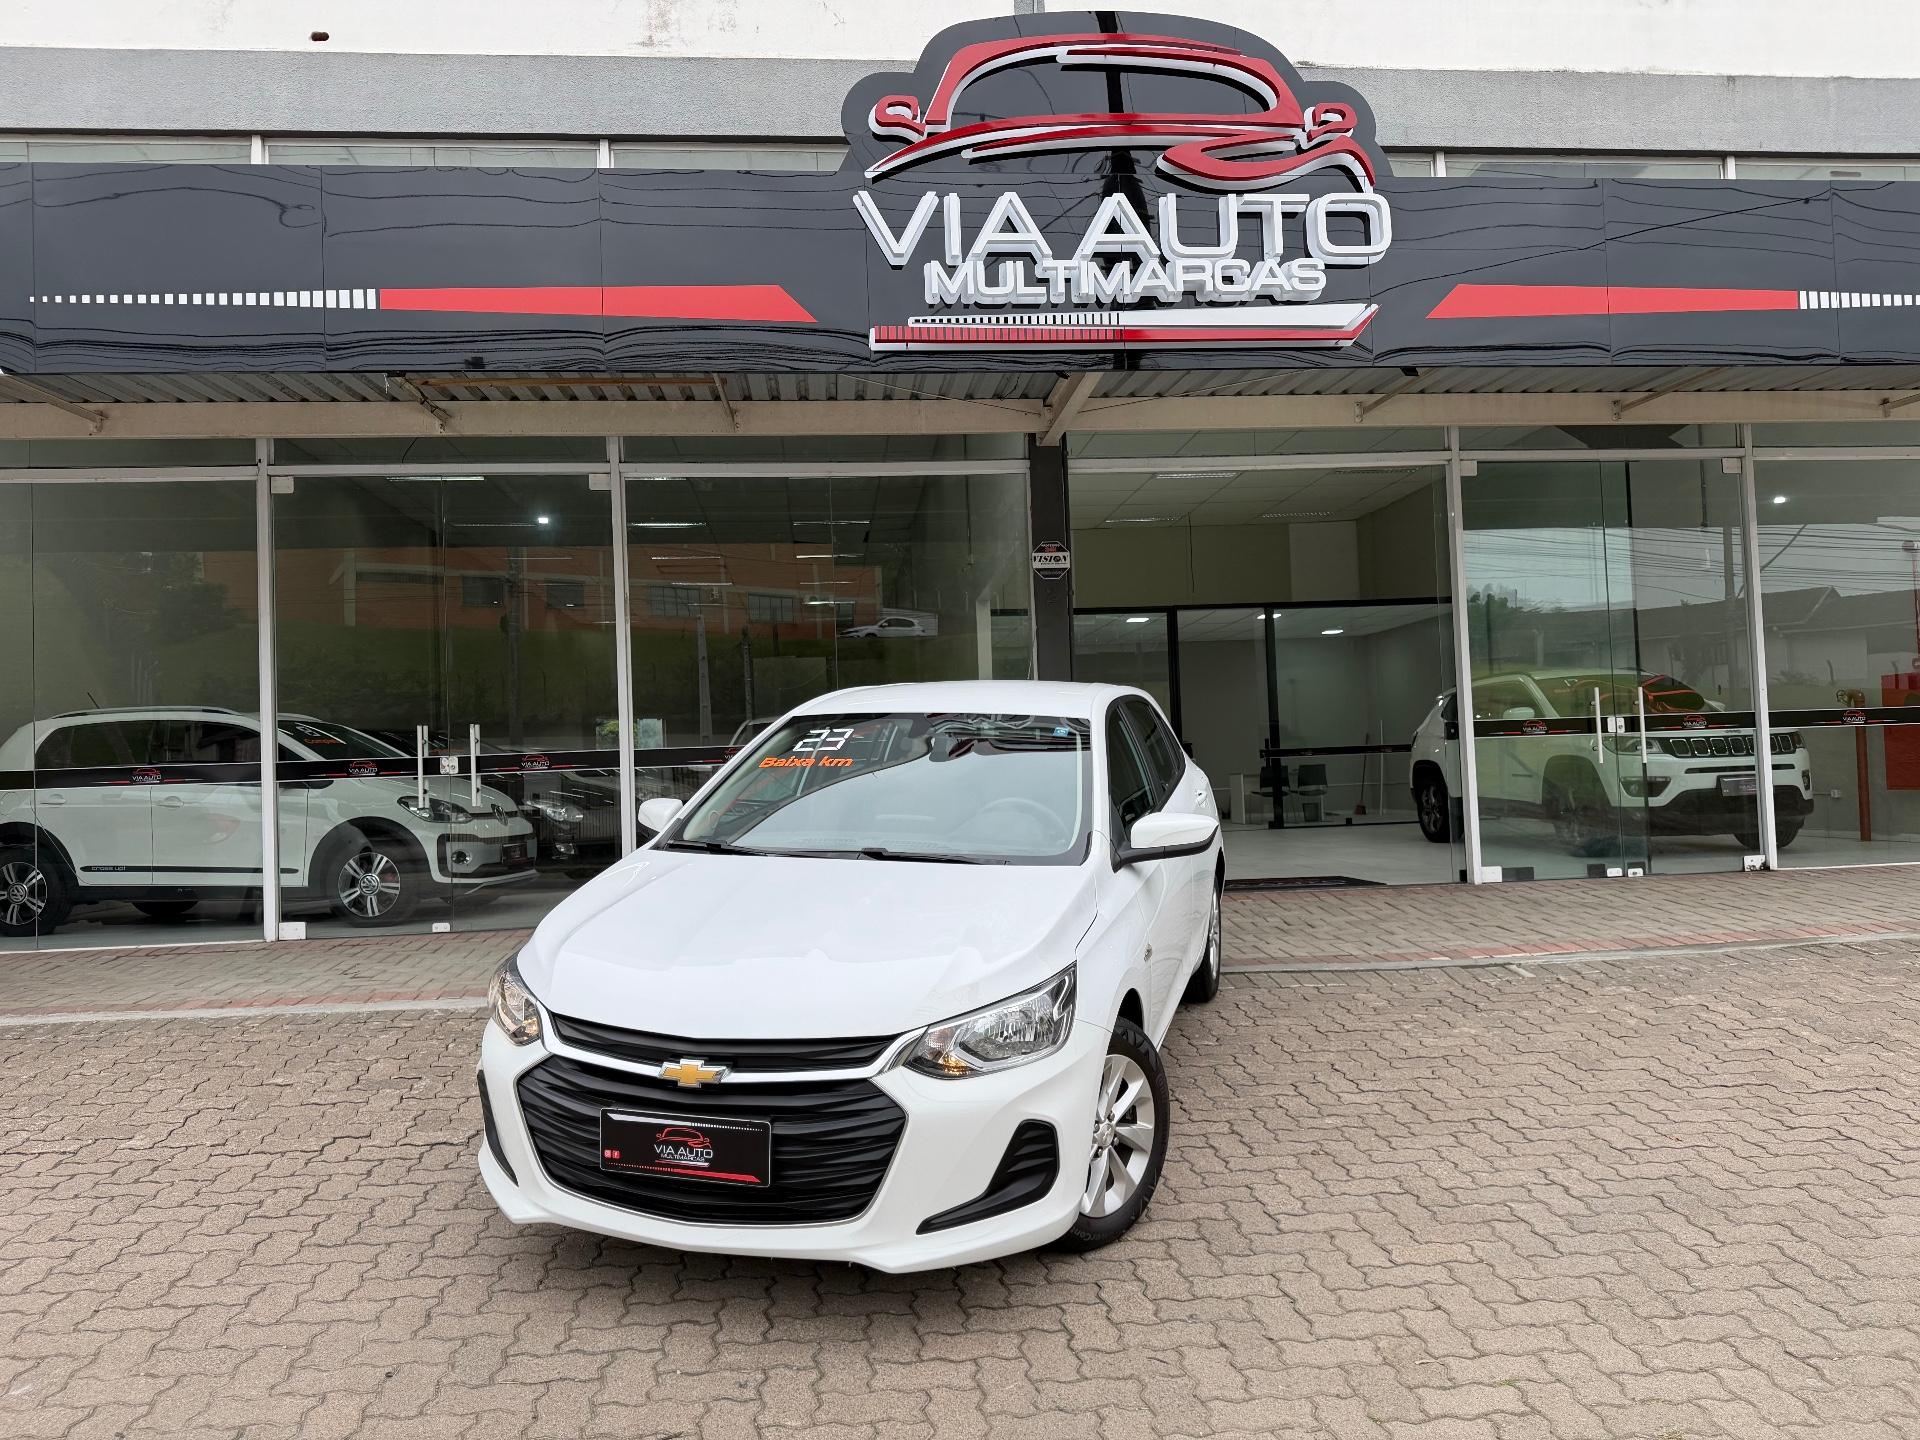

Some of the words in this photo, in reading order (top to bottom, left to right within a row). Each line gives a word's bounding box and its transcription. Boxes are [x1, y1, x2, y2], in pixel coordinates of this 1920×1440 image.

[853, 190, 1053, 266] VIA
[1077, 192, 1392, 264] AUTO
[924, 257, 1326, 304] MULTIMARCAS
[792, 728, 855, 752] 23
[758, 755, 817, 768] Baixa
[818, 755, 855, 768] km
[653, 1143, 676, 1155] VIA
[677, 1146, 714, 1159] AUTO
